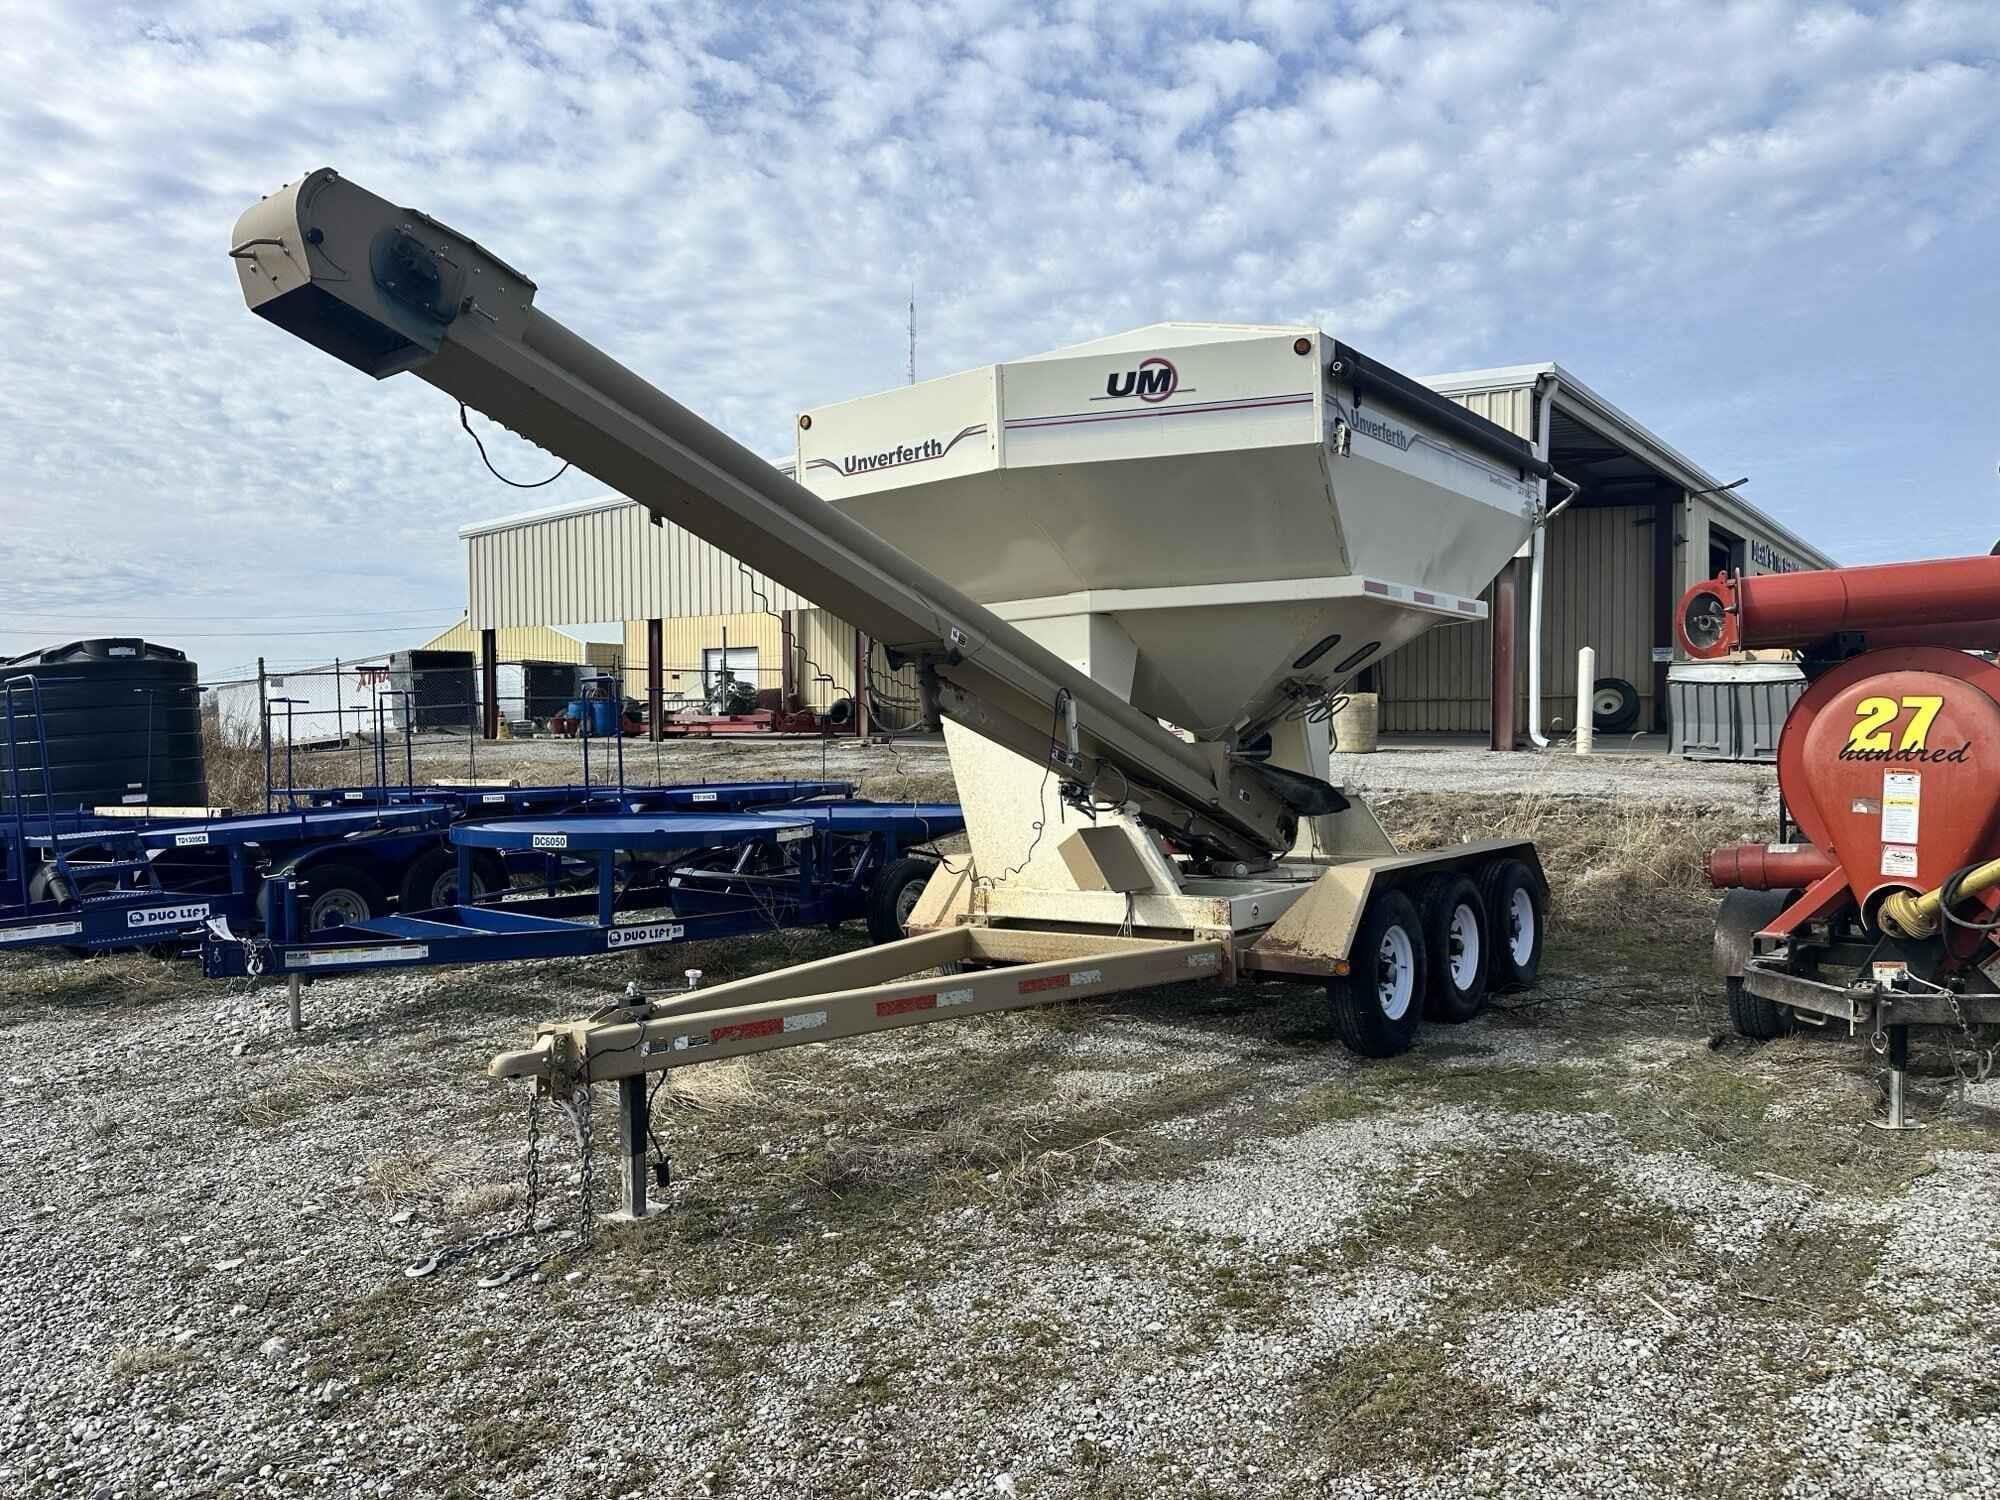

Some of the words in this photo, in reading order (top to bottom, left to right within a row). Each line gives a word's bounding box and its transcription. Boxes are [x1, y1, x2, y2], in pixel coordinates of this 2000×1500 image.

[1106, 367, 1171, 397] UM
[1350, 408, 1407, 449] Unverferth
[844, 438, 942, 473] Unverferth
[1848, 695, 1944, 754] 27
[1838, 737, 1972, 763] hundred
[534, 836, 566, 846] DC6050
[149, 910, 177, 922] DUO
[623, 930, 647, 942] DUO
